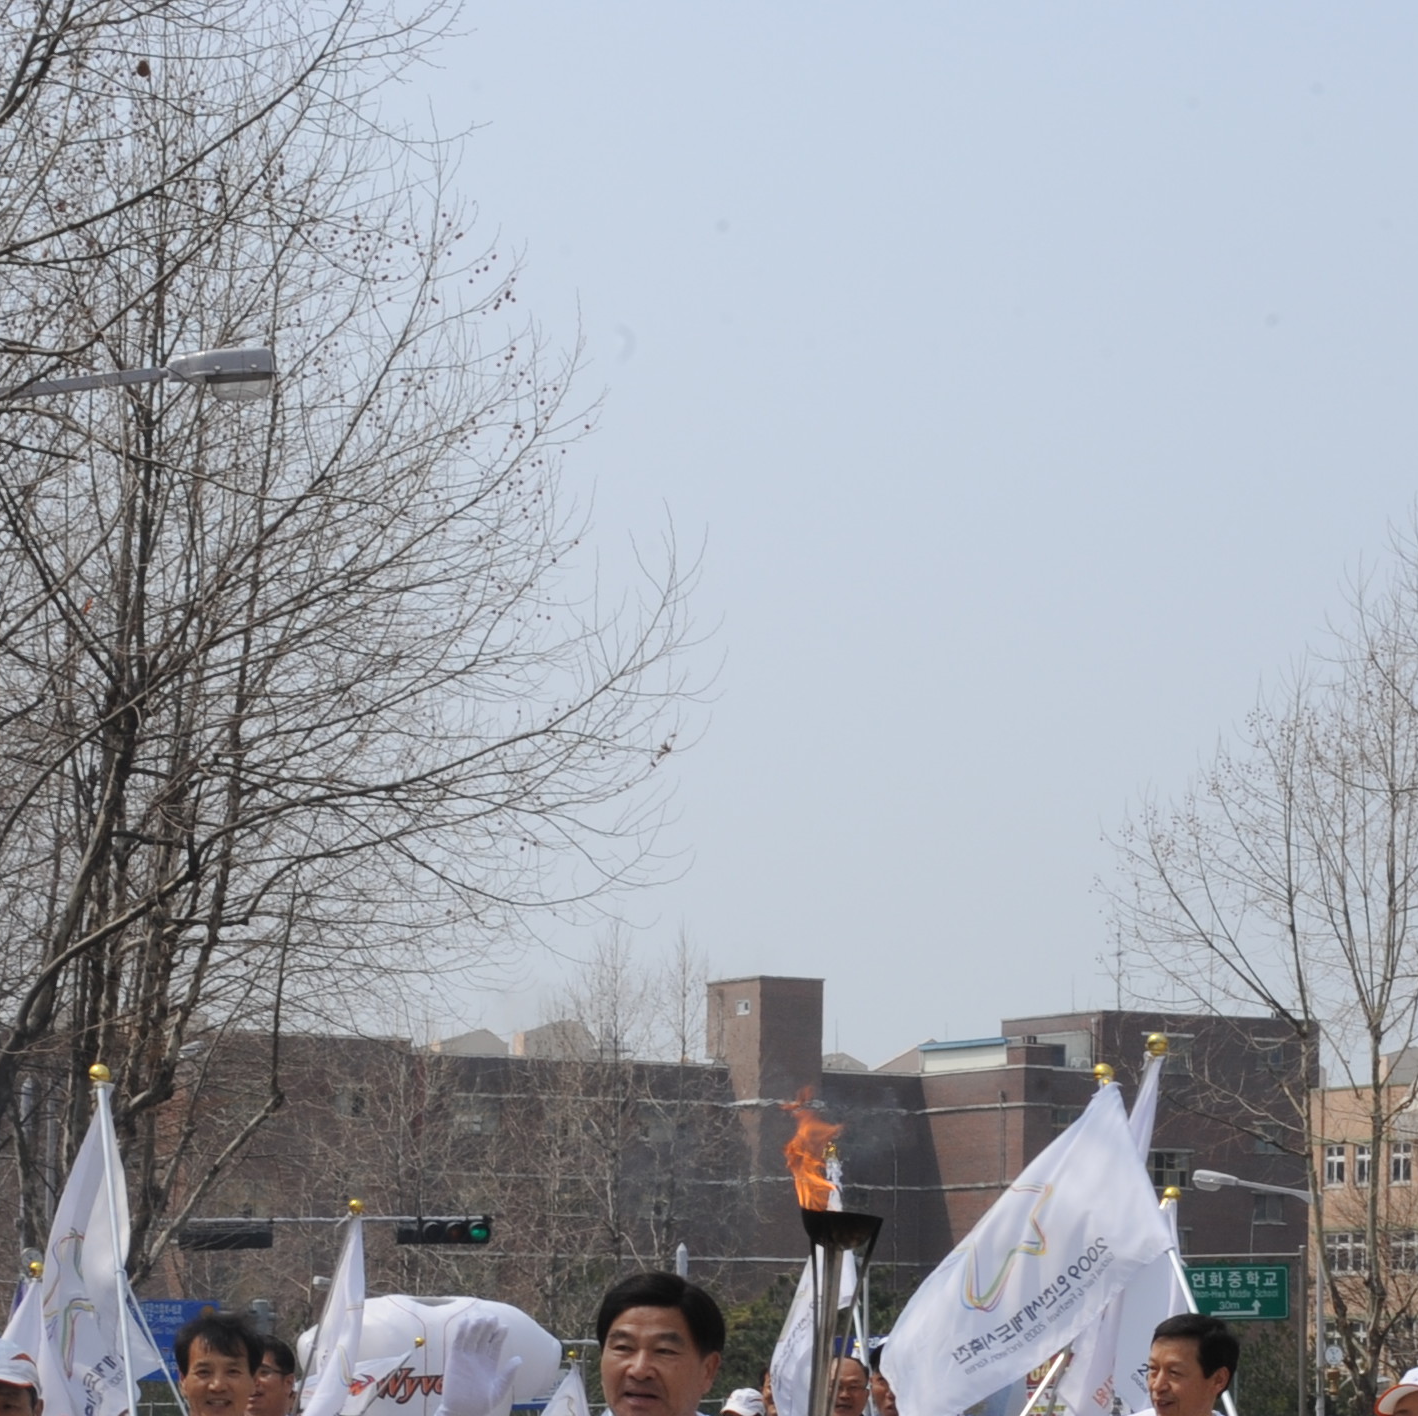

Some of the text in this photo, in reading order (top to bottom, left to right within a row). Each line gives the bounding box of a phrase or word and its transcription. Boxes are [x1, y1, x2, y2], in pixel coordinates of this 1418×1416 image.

[1191, 1270, 1278, 1289] 연화중학교
[1228, 1289, 1251, 1298] Middle
[1254, 1289, 1278, 1299] School
[1219, 1301, 1240, 1310] 30m
